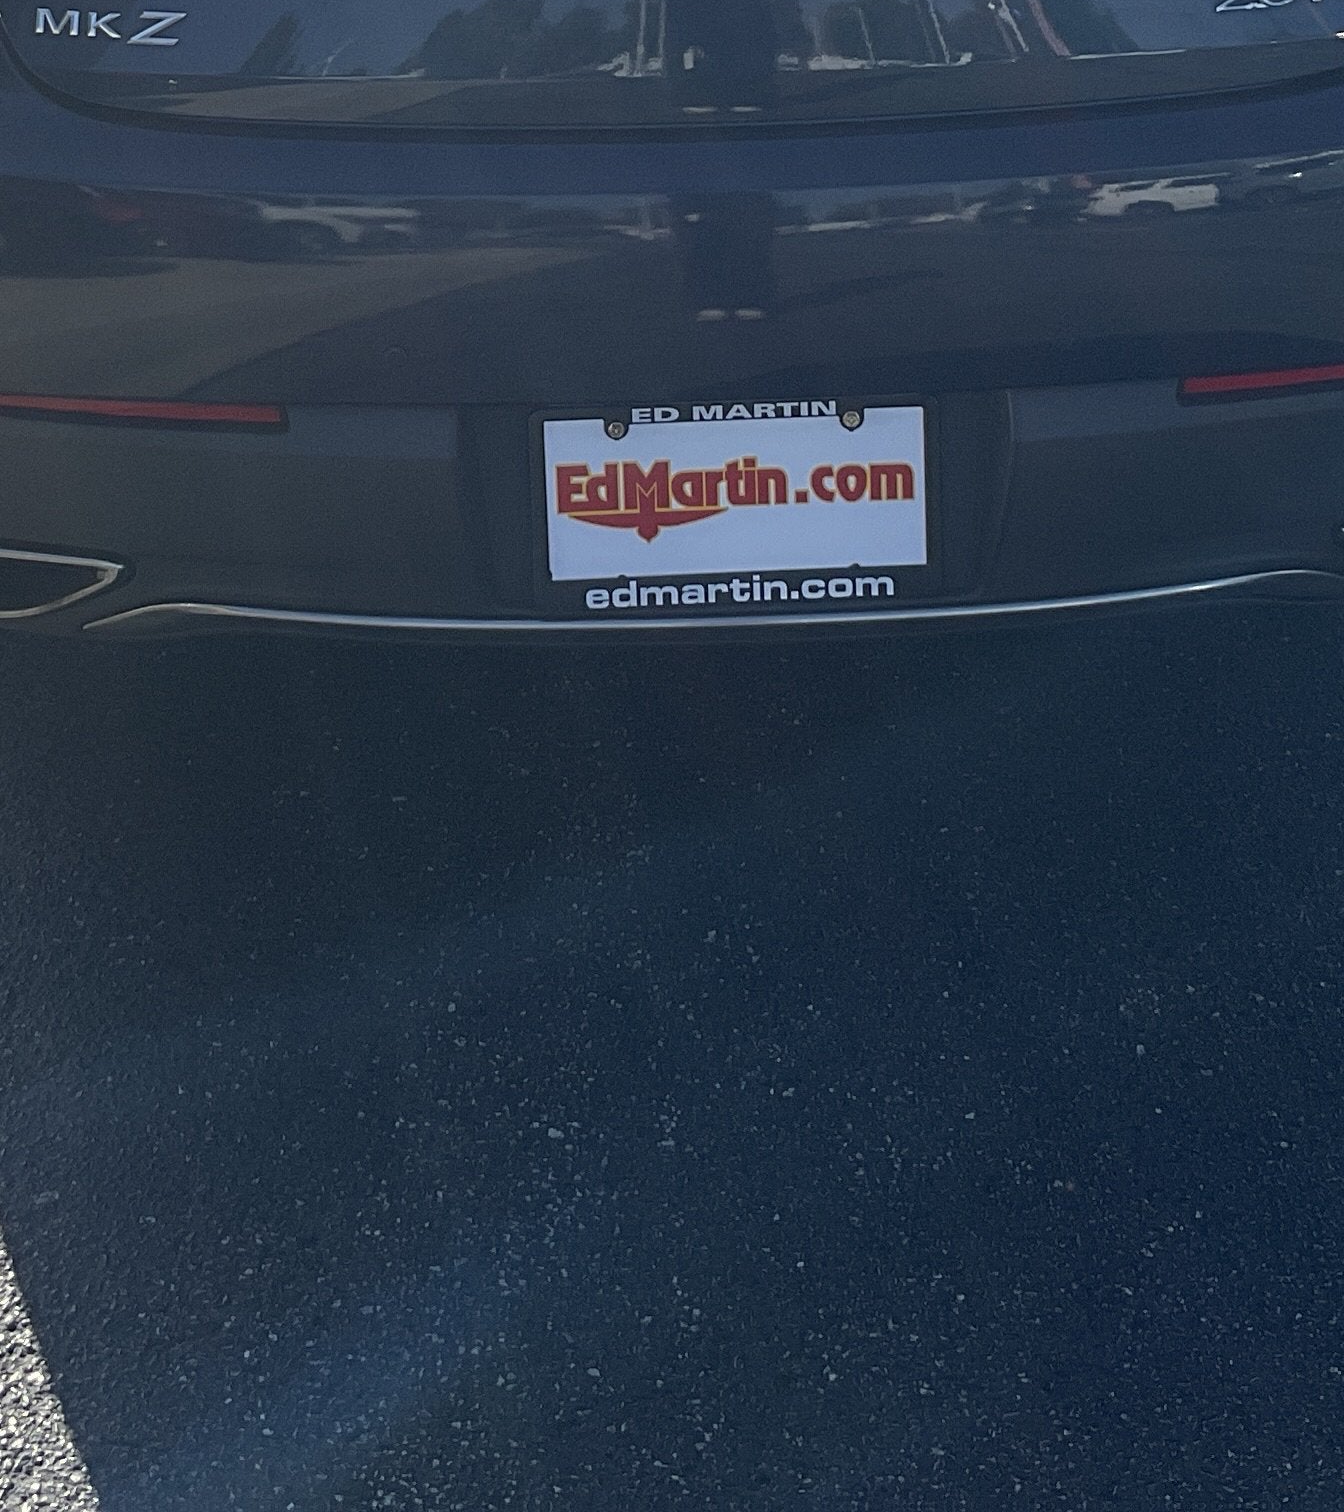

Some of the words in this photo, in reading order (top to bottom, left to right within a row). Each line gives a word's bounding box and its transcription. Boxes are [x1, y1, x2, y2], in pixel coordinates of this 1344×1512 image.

[35, 7, 188, 46] MKZ
[631, 407, 681, 424] ED
[692, 399, 837, 421] MARTIN
[555, 455, 916, 523] EdMartin.com
[585, 574, 896, 610] edmartin.com
